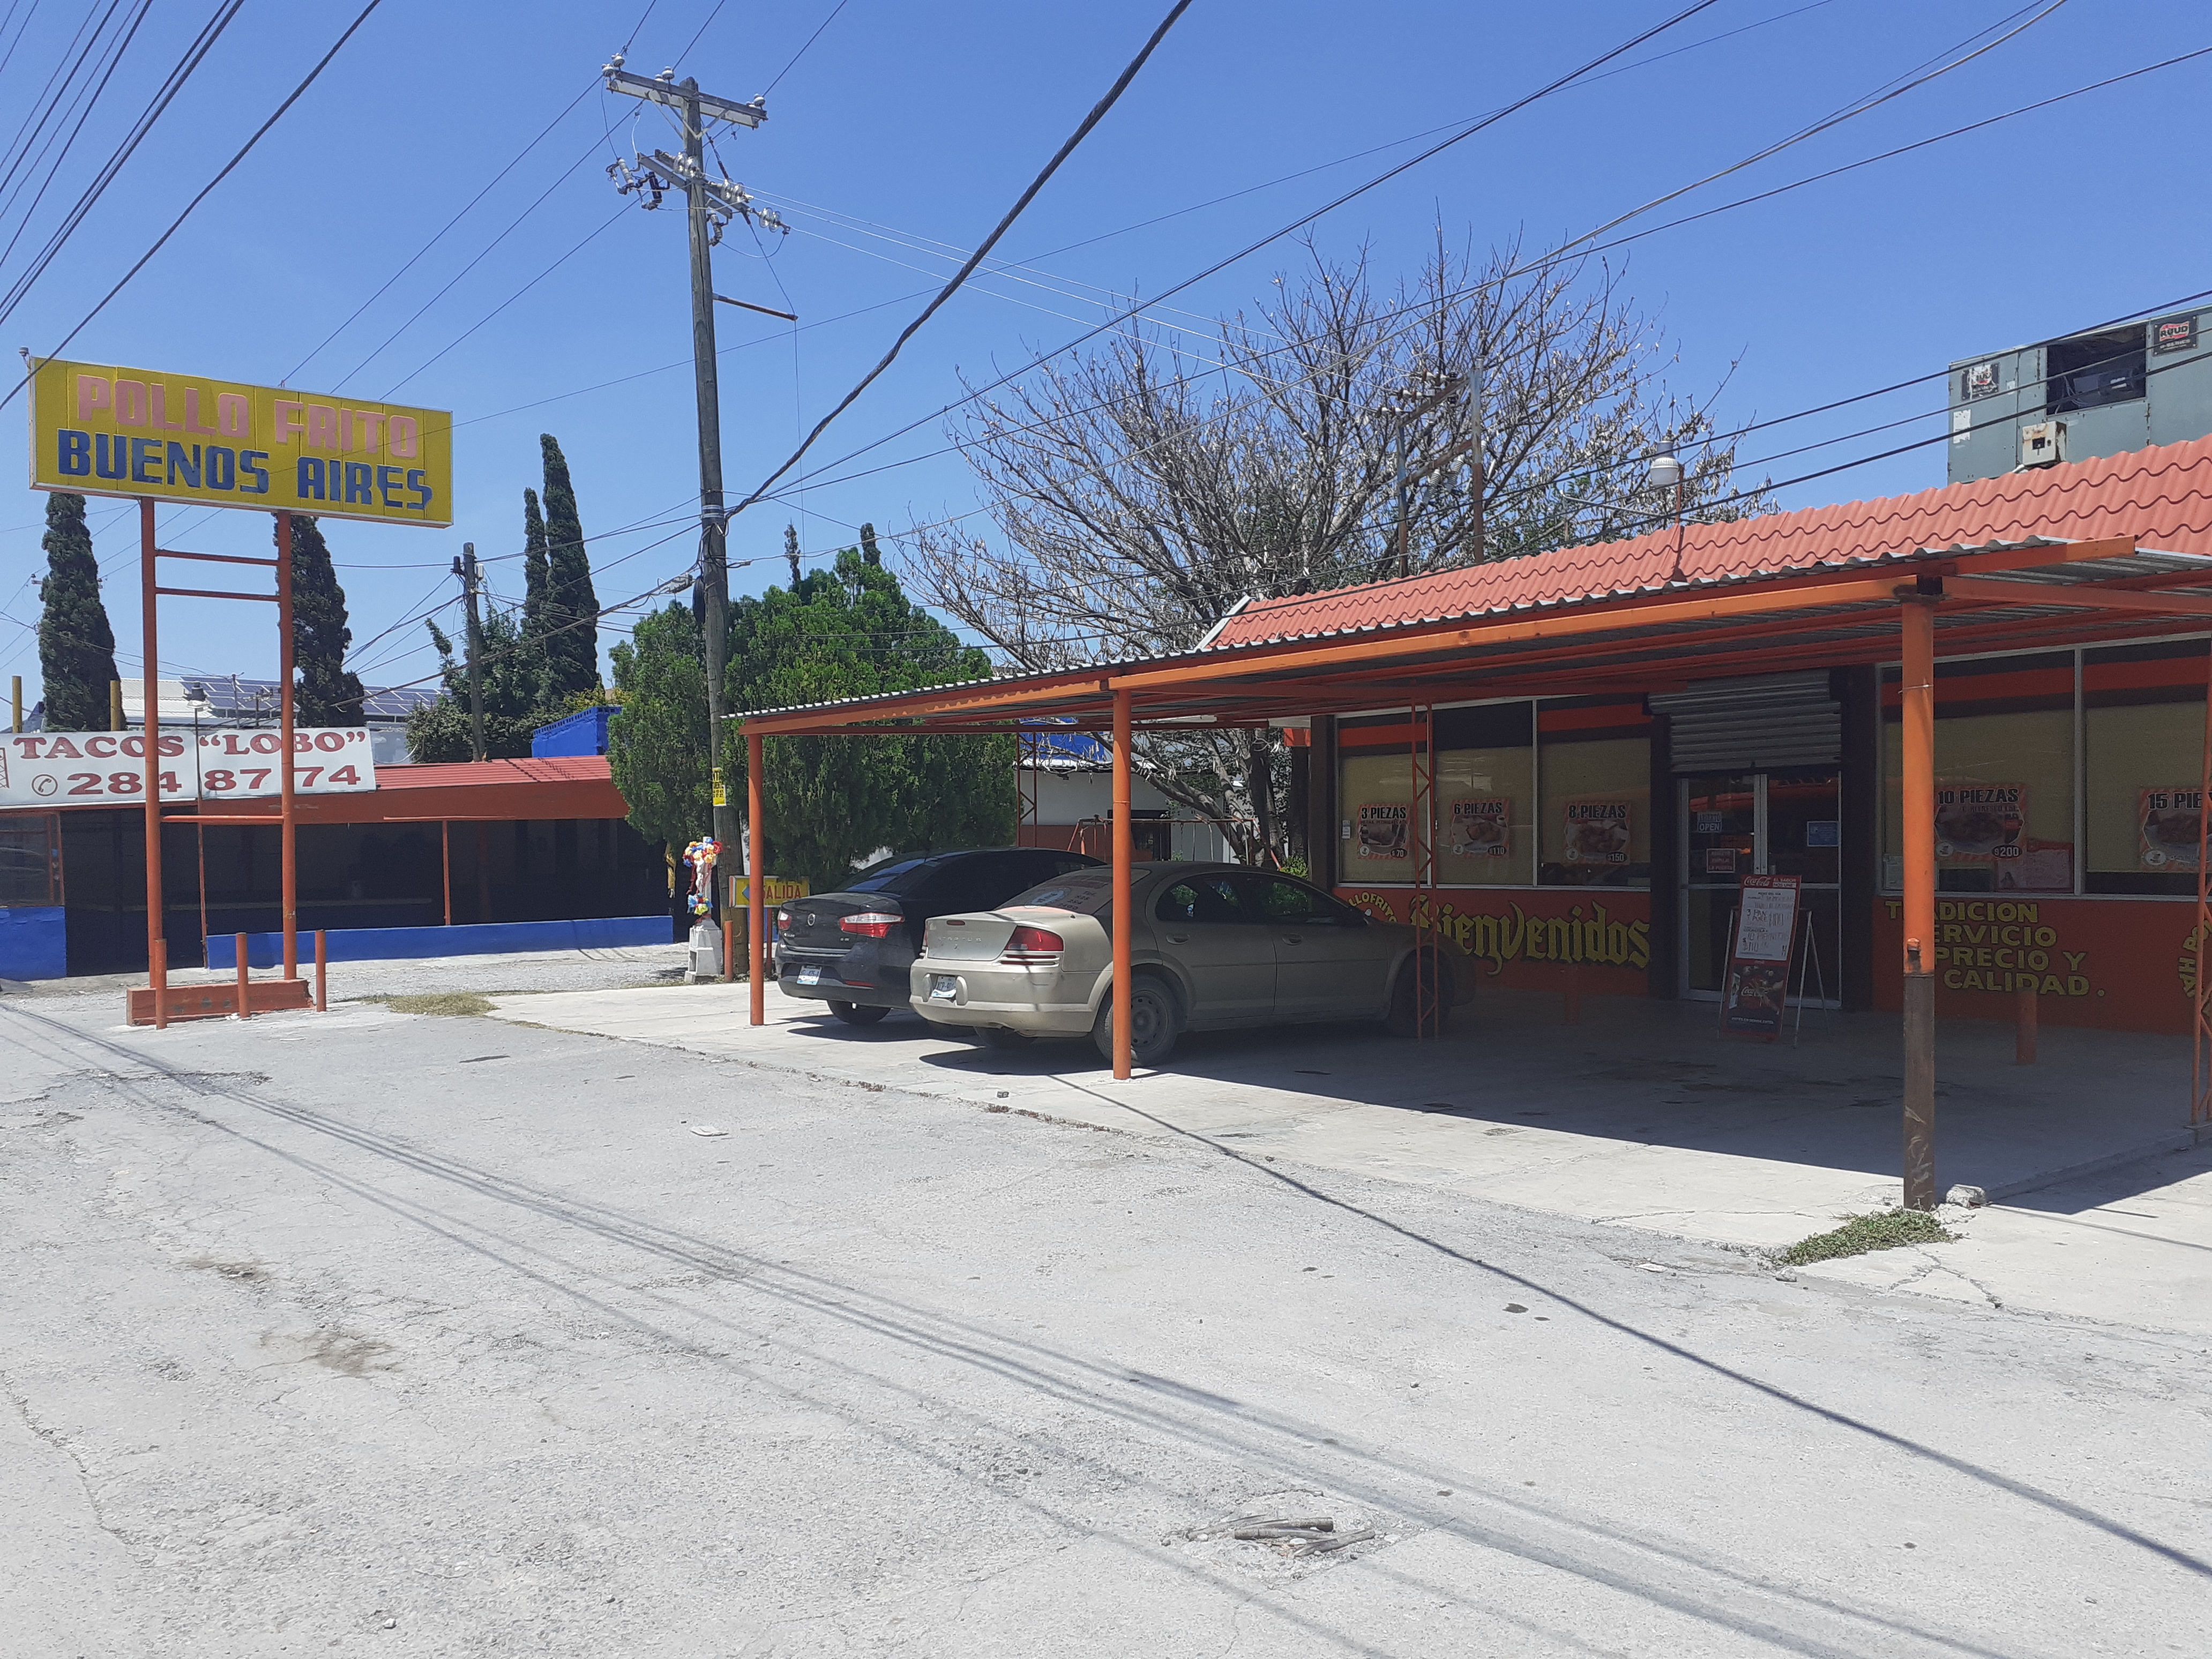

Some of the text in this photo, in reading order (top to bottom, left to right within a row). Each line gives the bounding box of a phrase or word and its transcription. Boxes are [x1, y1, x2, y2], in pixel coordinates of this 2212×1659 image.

[2160, 325, 2188, 337] RUUD
[77, 374, 417, 459] POLLO FRITO
[57, 428, 432, 511] BUENOS AIRES
[13, 736, 185, 759] TACOS
[67, 765, 361, 795] 284 87 74
[1938, 788, 2020, 804] 10 PIEZAS
[2148, 793, 2169, 810] 15
[1361, 806, 1407, 819] 3 PIEZAS
[1454, 802, 1503, 814] 6 PIEZAS
[1568, 804, 1627, 819] 8 PIEZAS
[1699, 823, 1720, 832] OPEN
[1994, 846, 2020, 857] $200
[764, 885, 801, 899] ALIDA
[1885, 901, 2038, 923] TDICION
[1934, 947, 2087, 971] PRECIO Y
